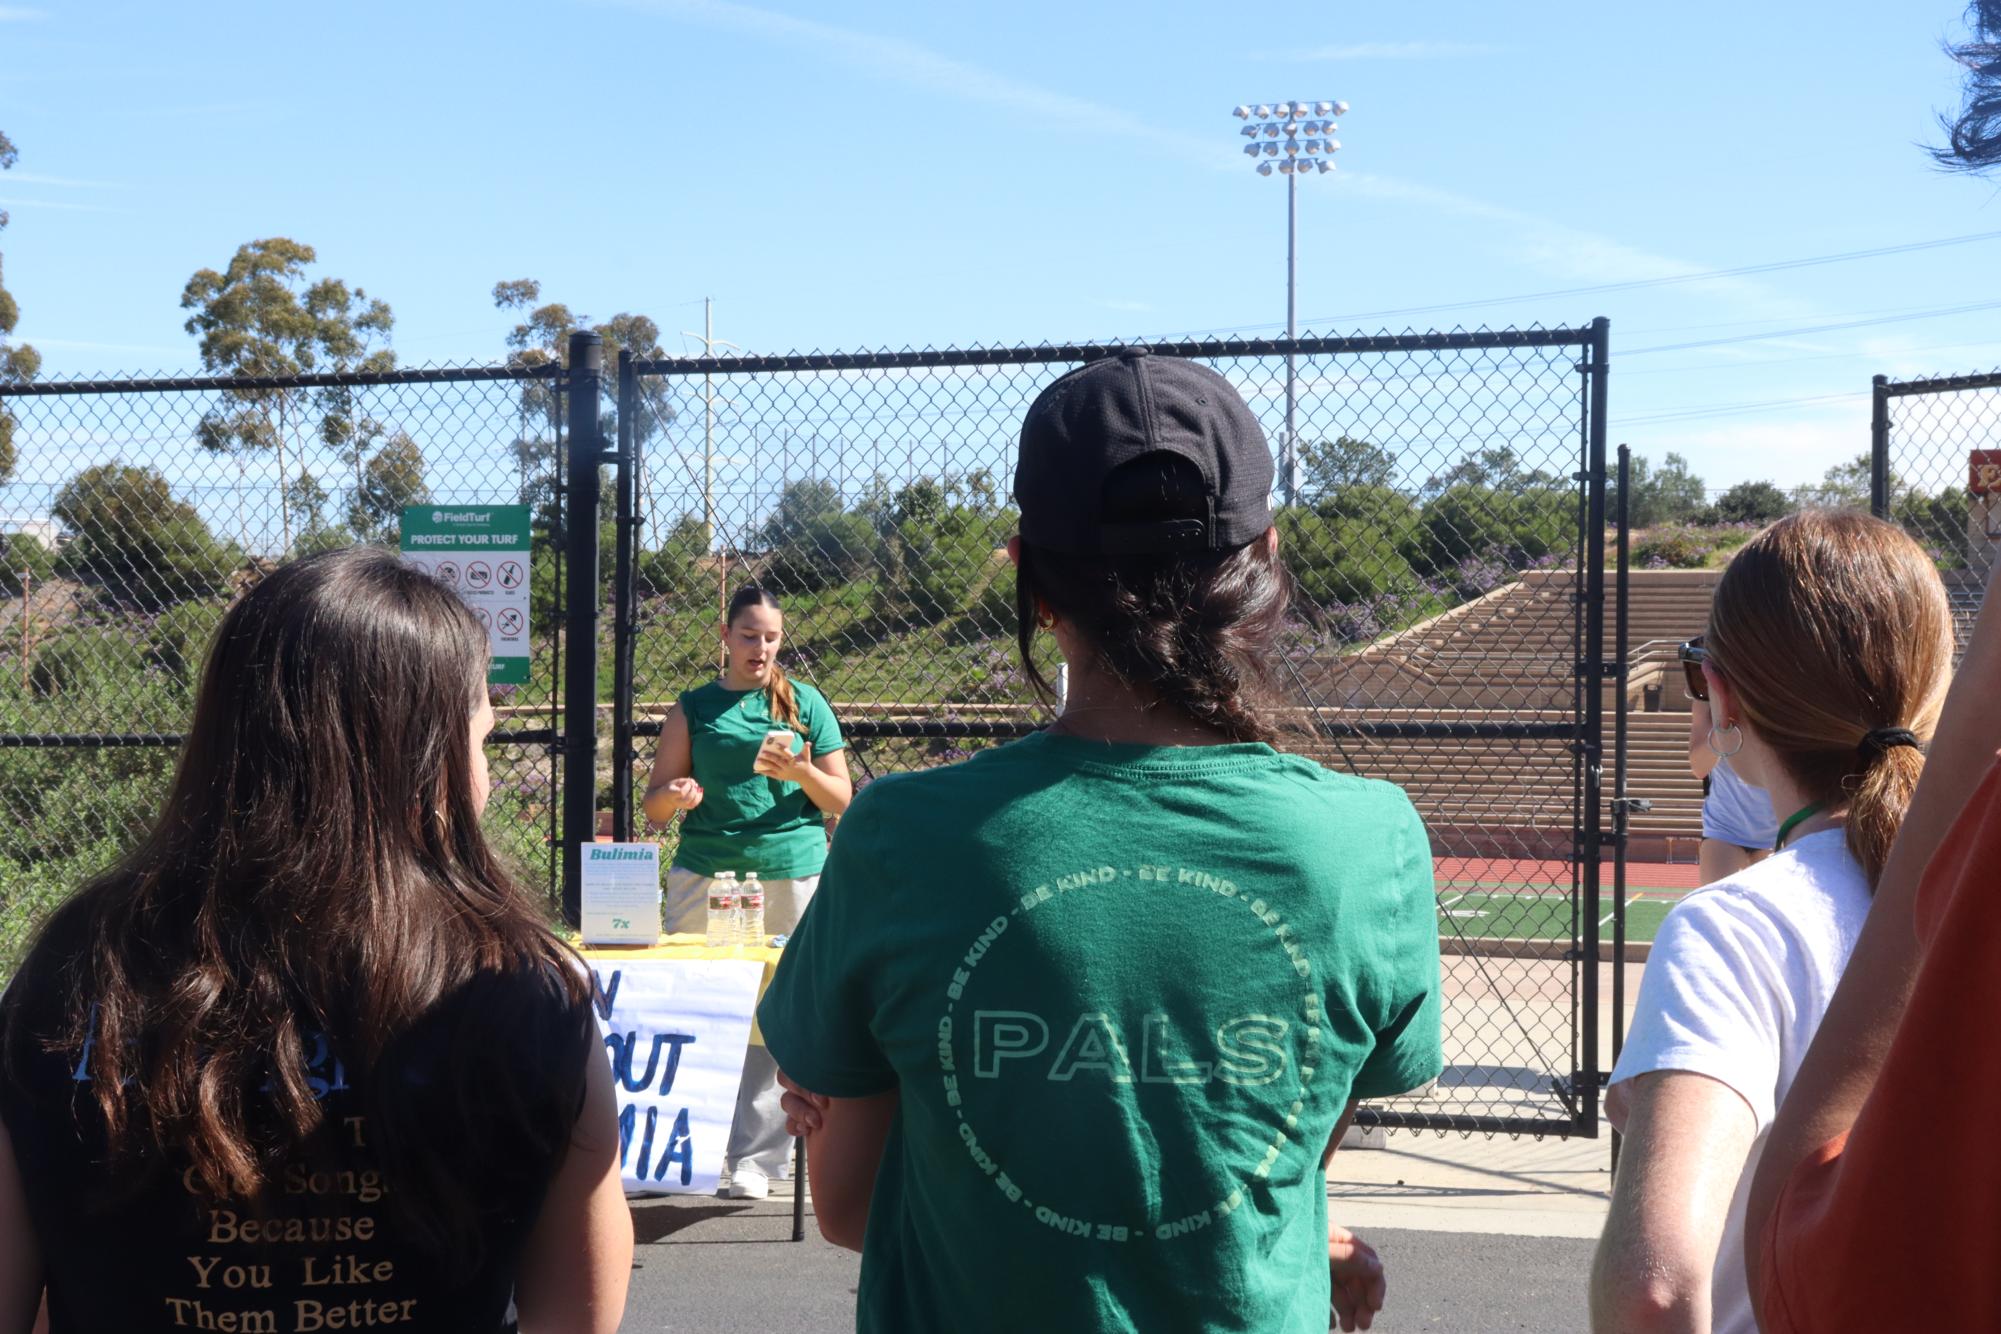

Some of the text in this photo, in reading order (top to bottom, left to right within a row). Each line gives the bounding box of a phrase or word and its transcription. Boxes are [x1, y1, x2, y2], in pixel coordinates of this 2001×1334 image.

[443, 511, 491, 522] FieldTurf
[410, 534, 519, 545] PROTECT YOUR TURF
[590, 848, 653, 860] Bulimia
[1056, 865, 1117, 892] KIND
[1178, 867, 1238, 898] KIND
[612, 918, 630, 929] 7x
[964, 915, 1009, 968] KIND
[946, 967, 970, 1000] BE
[938, 1015, 956, 1071] KIND
[973, 1009, 1290, 1087] PALS
[943, 1074, 962, 1107] BE
[959, 1122, 998, 1175] KIND
[995, 1171, 1023, 1203] BE
[207, 1209, 376, 1244] Because
[1035, 1206, 1092, 1238] KIND
[1096, 1223, 1129, 1242] BE
[1155, 1210, 1212, 1241] KIND
[187, 1254, 396, 1289] You Like
[164, 1297, 418, 1334] Them Better
